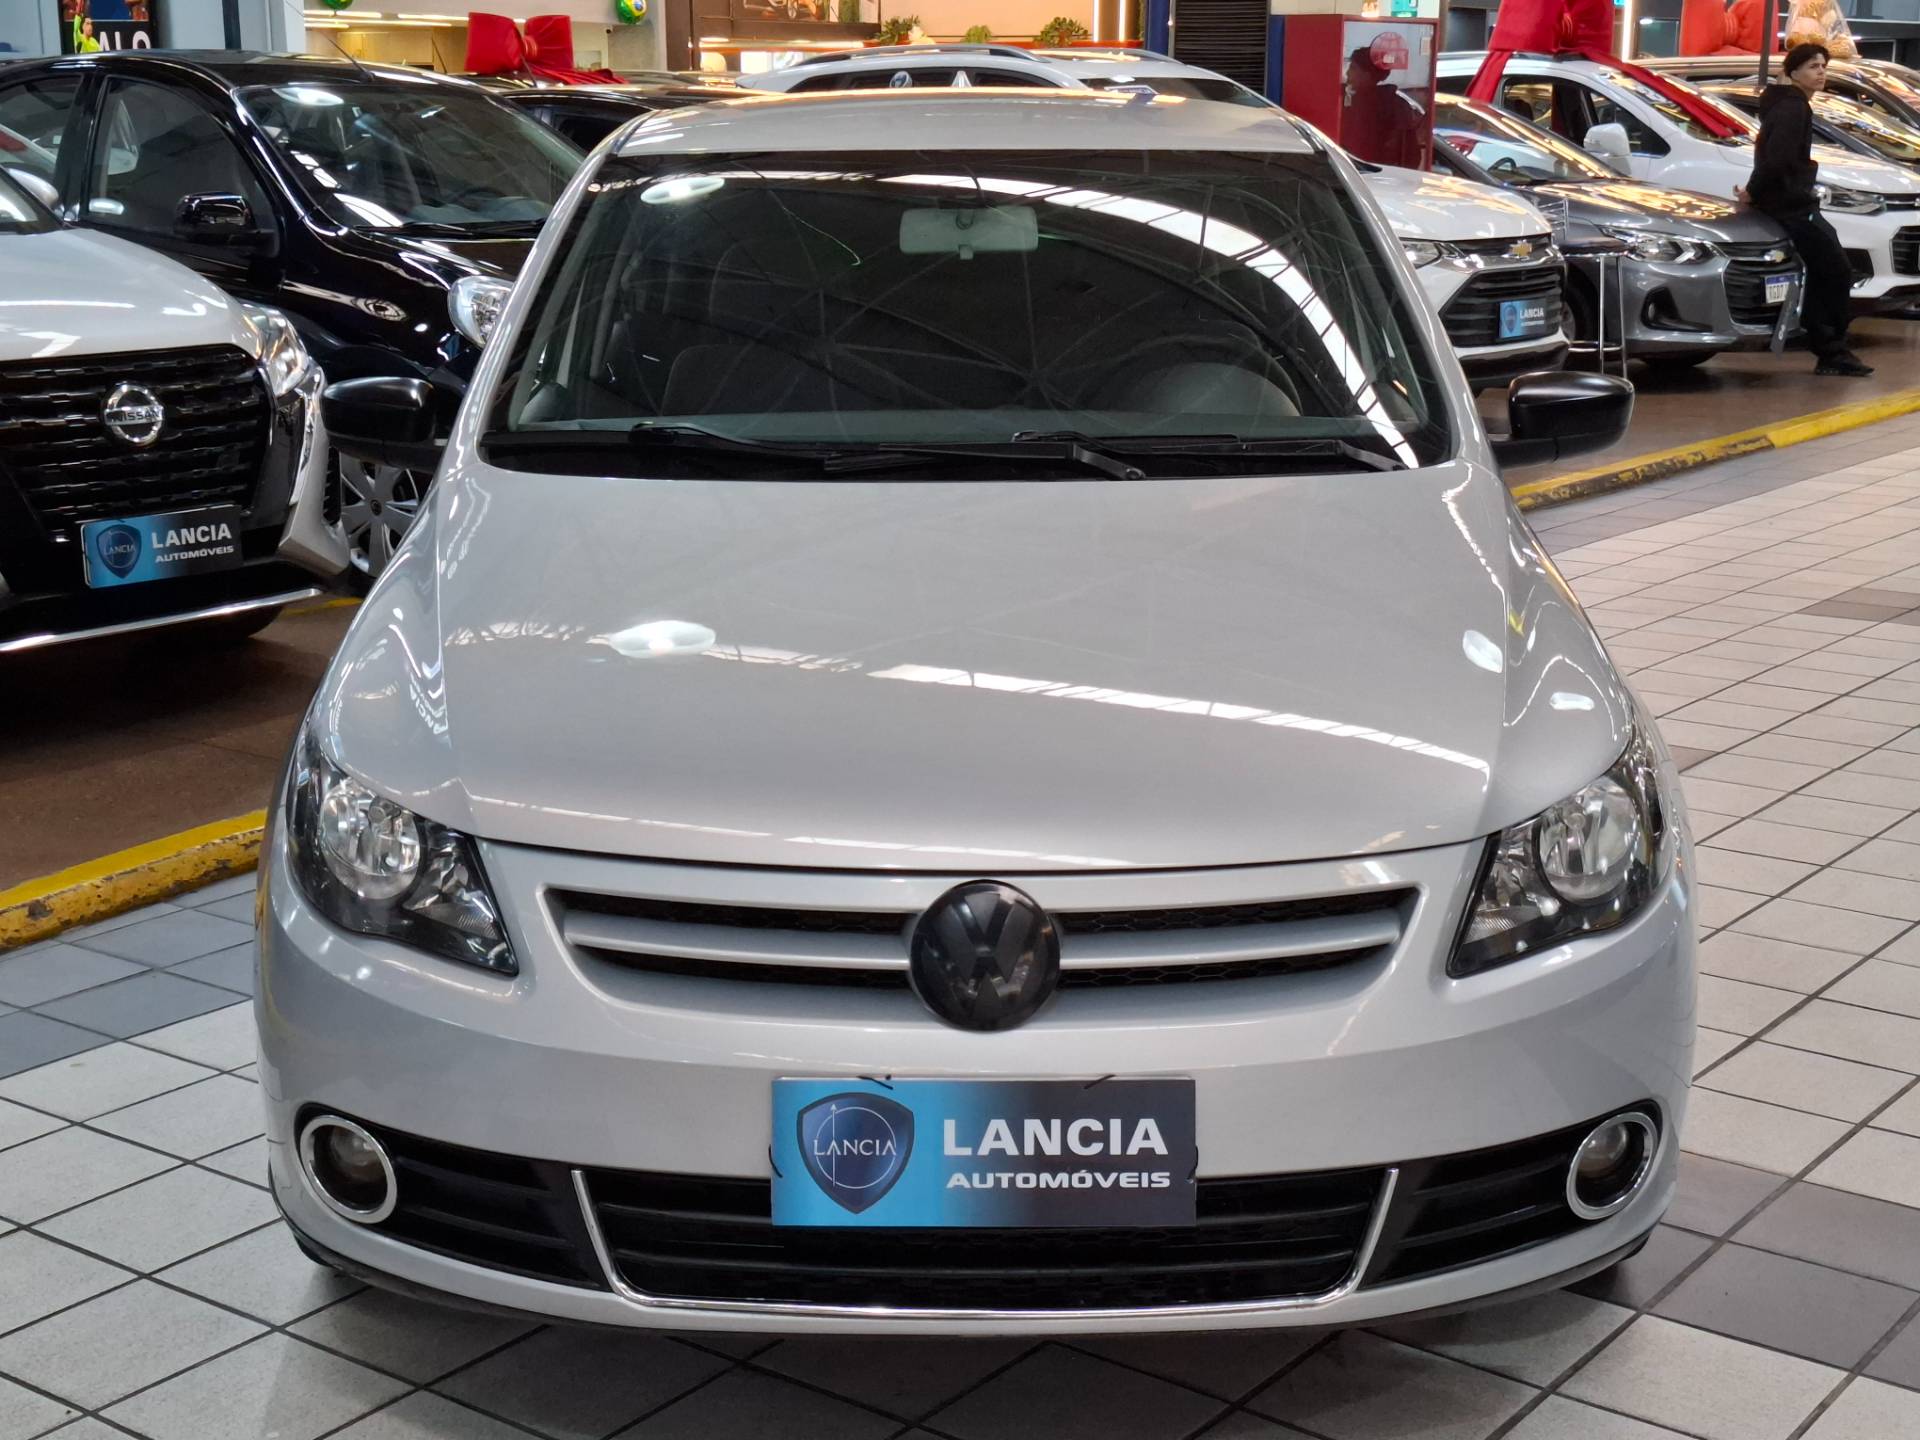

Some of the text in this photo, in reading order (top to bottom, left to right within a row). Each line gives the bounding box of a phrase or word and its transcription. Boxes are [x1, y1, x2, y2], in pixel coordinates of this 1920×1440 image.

[1520, 307, 1545, 319] LANCIA
[110, 409, 160, 422] NISSAN
[152, 523, 232, 549] LANCIA
[104, 544, 136, 555] LANCIA
[943, 1118, 1169, 1156] LANCIA
[813, 1139, 897, 1156] LANCIA
[946, 1169, 1171, 1189] AUTOMÓVEIS
